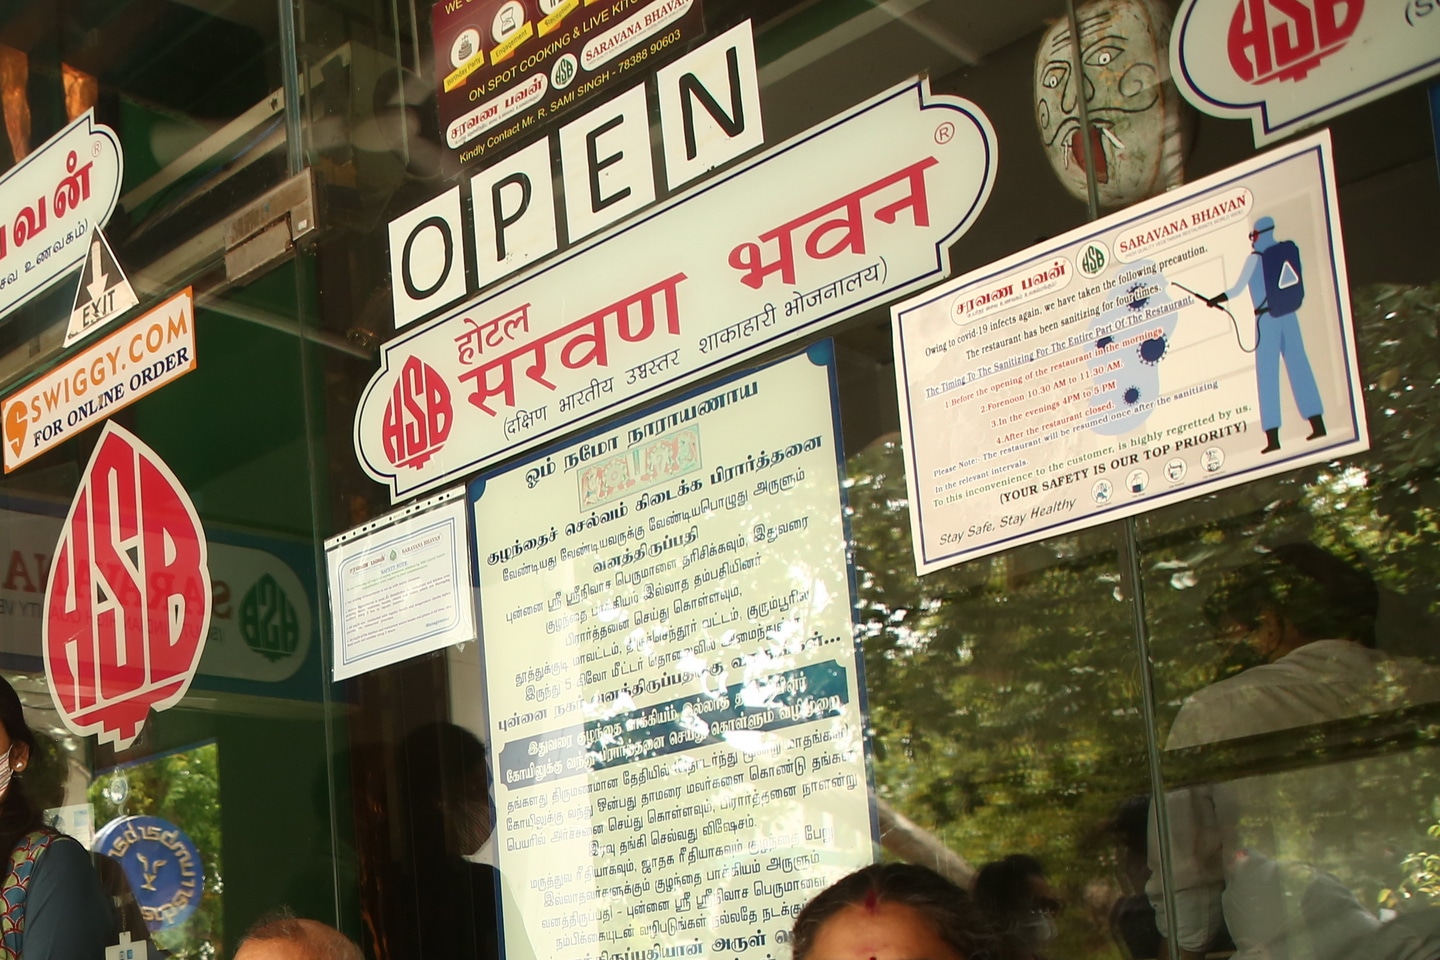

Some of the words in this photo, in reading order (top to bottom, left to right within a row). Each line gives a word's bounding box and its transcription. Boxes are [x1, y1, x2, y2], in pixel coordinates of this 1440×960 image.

[468, 85, 486, 102] ON
[487, 65, 517, 92] SPOT
[519, 32, 571, 72] COOKING
[572, 26, 581, 39] &
[582, 8, 610, 33] LIVE
[468, 56, 482, 70] Party
[555, 52, 574, 87] HSB
[585, 21, 642, 62] SARAVANA
[459, 143, 486, 165] Kindly
[486, 122, 520, 148] Contact
[521, 115, 536, 129] Mr.
[537, 107, 548, 120] R.
[550, 90, 575, 113] SAMI
[577, 70, 610, 97] SINGH
[618, 48, 648, 73] 78388
[649, 28, 681, 55] 90603
[401, 46, 745, 300] OPEN
[24, 218, 88, 274] உணவகம்)
[1119, 218, 1189, 253] SARAVANA
[1191, 194, 1246, 226] BHAVAN
[457, 271, 688, 417] सरवण
[727, 155, 940, 290] भवन
[1021, 260, 1066, 291] பவன்
[1082, 245, 1105, 274] HSB
[81, 290, 115, 327] EXIT
[453, 302, 532, 365] होटल
[925, 341, 948, 357] Owing
[948, 338, 956, 348] to
[957, 323, 988, 344] covid-19
[989, 316, 1017, 331] infects
[1018, 307, 1043, 323] again,
[1044, 302, 1055, 312] we
[1056, 294, 1076, 308] have
[1077, 285, 1101, 300] taken
[1102, 279, 1117, 291] the
[1118, 263, 1157, 285] following
[1158, 245, 1208, 273] precaution.
[965, 348, 980, 360] The
[981, 333, 1022, 354] restaurant
[1023, 329, 1038, 340] has
[1039, 321, 1059, 335] been
[1060, 305, 1101, 327] sanitizing
[1102, 301, 1114, 312] for
[1115, 288, 1135, 307] four
[1132, 283, 1159, 303] times.
[30, 308, 188, 424] SWIGGY.COM
[503, 405, 548, 442] (दक्षिण
[558, 376, 614, 413] भारतीय
[698, 302, 777, 354] शाकाहारी
[784, 255, 888, 317] भोजनालय)
[33, 418, 64, 448] FOR
[67, 382, 125, 427] ONLINE
[129, 347, 189, 391] ORDER
[383, 355, 454, 470] HSB
[523, 457, 557, 489] ஓம்
[563, 435, 619, 473] நமோ
[999, 484, 1039, 505] (YOUR
[1041, 468, 1089, 491] SAFETY
[1093, 463, 1106, 475] IS
[1110, 453, 1139, 470] OUR
[1143, 444, 1170, 460] TOP
[1175, 420, 1247, 452] PRIORITY)
[565, 501, 629, 536] செல்வம்
[635, 478, 703, 512] கிடைக்க
[939, 531, 965, 546] Stay
[967, 521, 996, 538] Safe,
[999, 513, 1027, 528] Stay
[1030, 498, 1077, 519] Healthy
[47, 430, 207, 720] HSB
